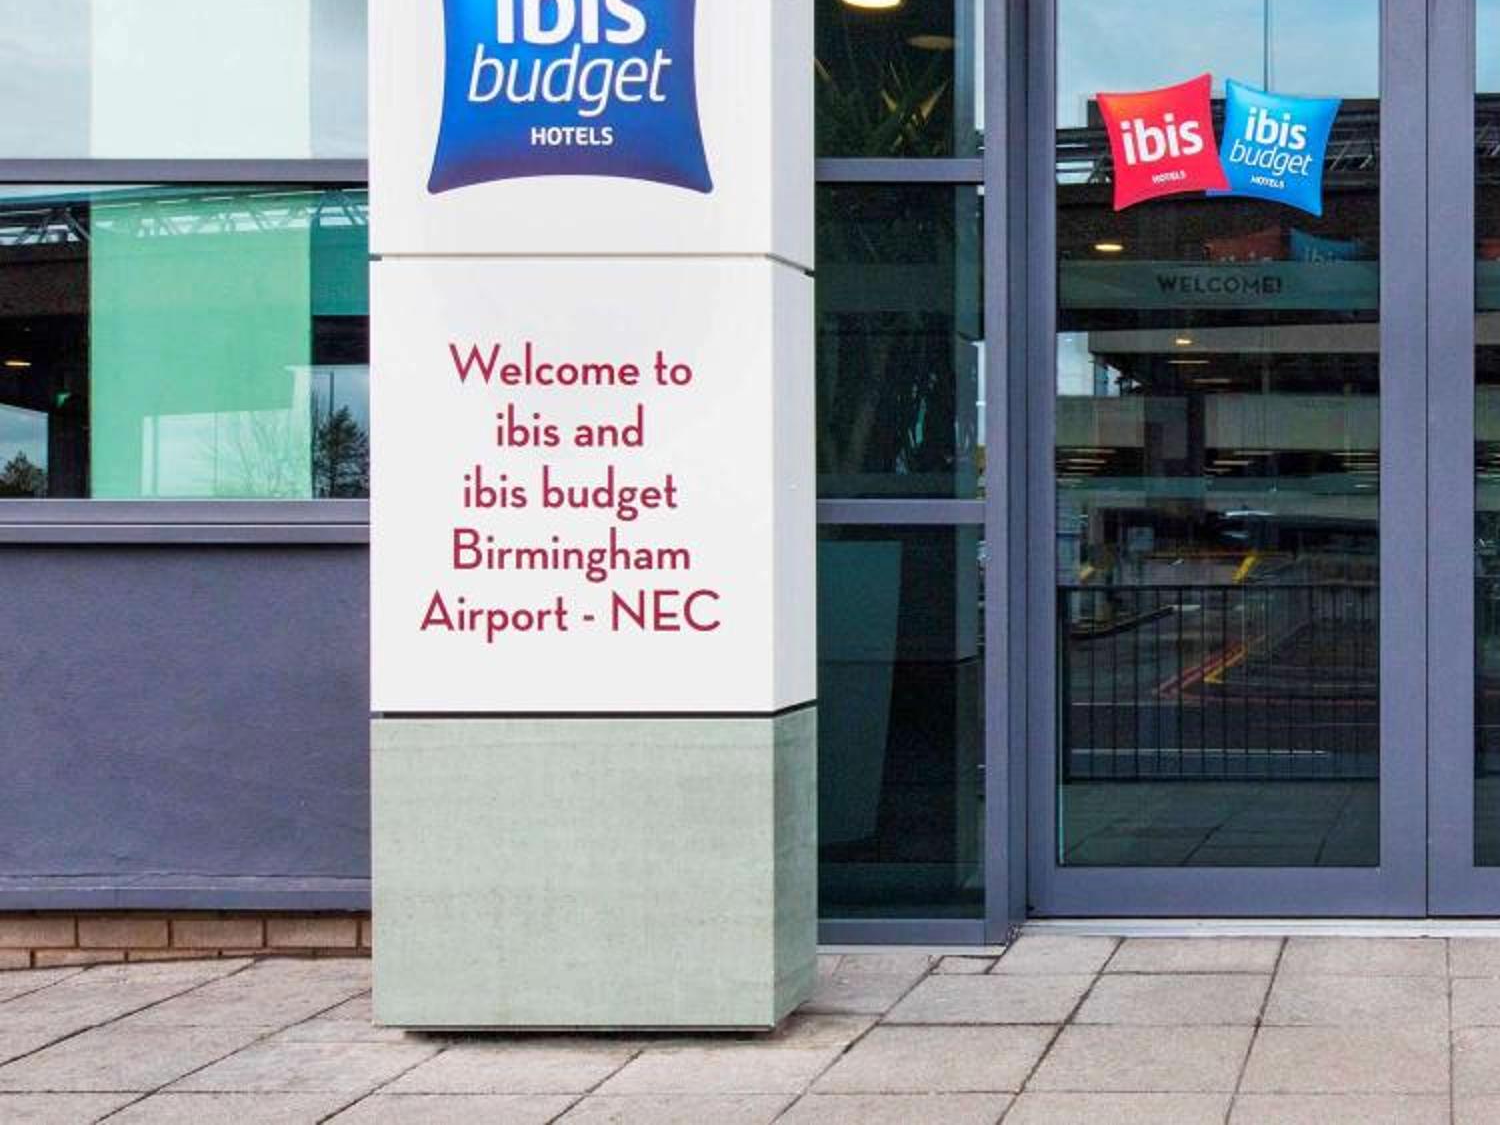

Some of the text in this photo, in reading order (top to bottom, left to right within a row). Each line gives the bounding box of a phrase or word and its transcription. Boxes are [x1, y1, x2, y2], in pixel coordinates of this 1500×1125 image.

[467, 43, 673, 117] budget
[530, 126, 614, 147] HOTELS
[1120, 112, 1204, 166] ibis
[1243, 106, 1308, 151] ibis
[1229, 138, 1314, 177] budget
[1156, 275, 1283, 295] WELCOME!
[448, 341, 693, 386] Welcome to
[496, 403, 644, 447] ibis and
[463, 464, 678, 522] ibis budget
[452, 526, 691, 584] Birmingham
[419, 590, 568, 644] Airport
[611, 589, 722, 632] NEC
